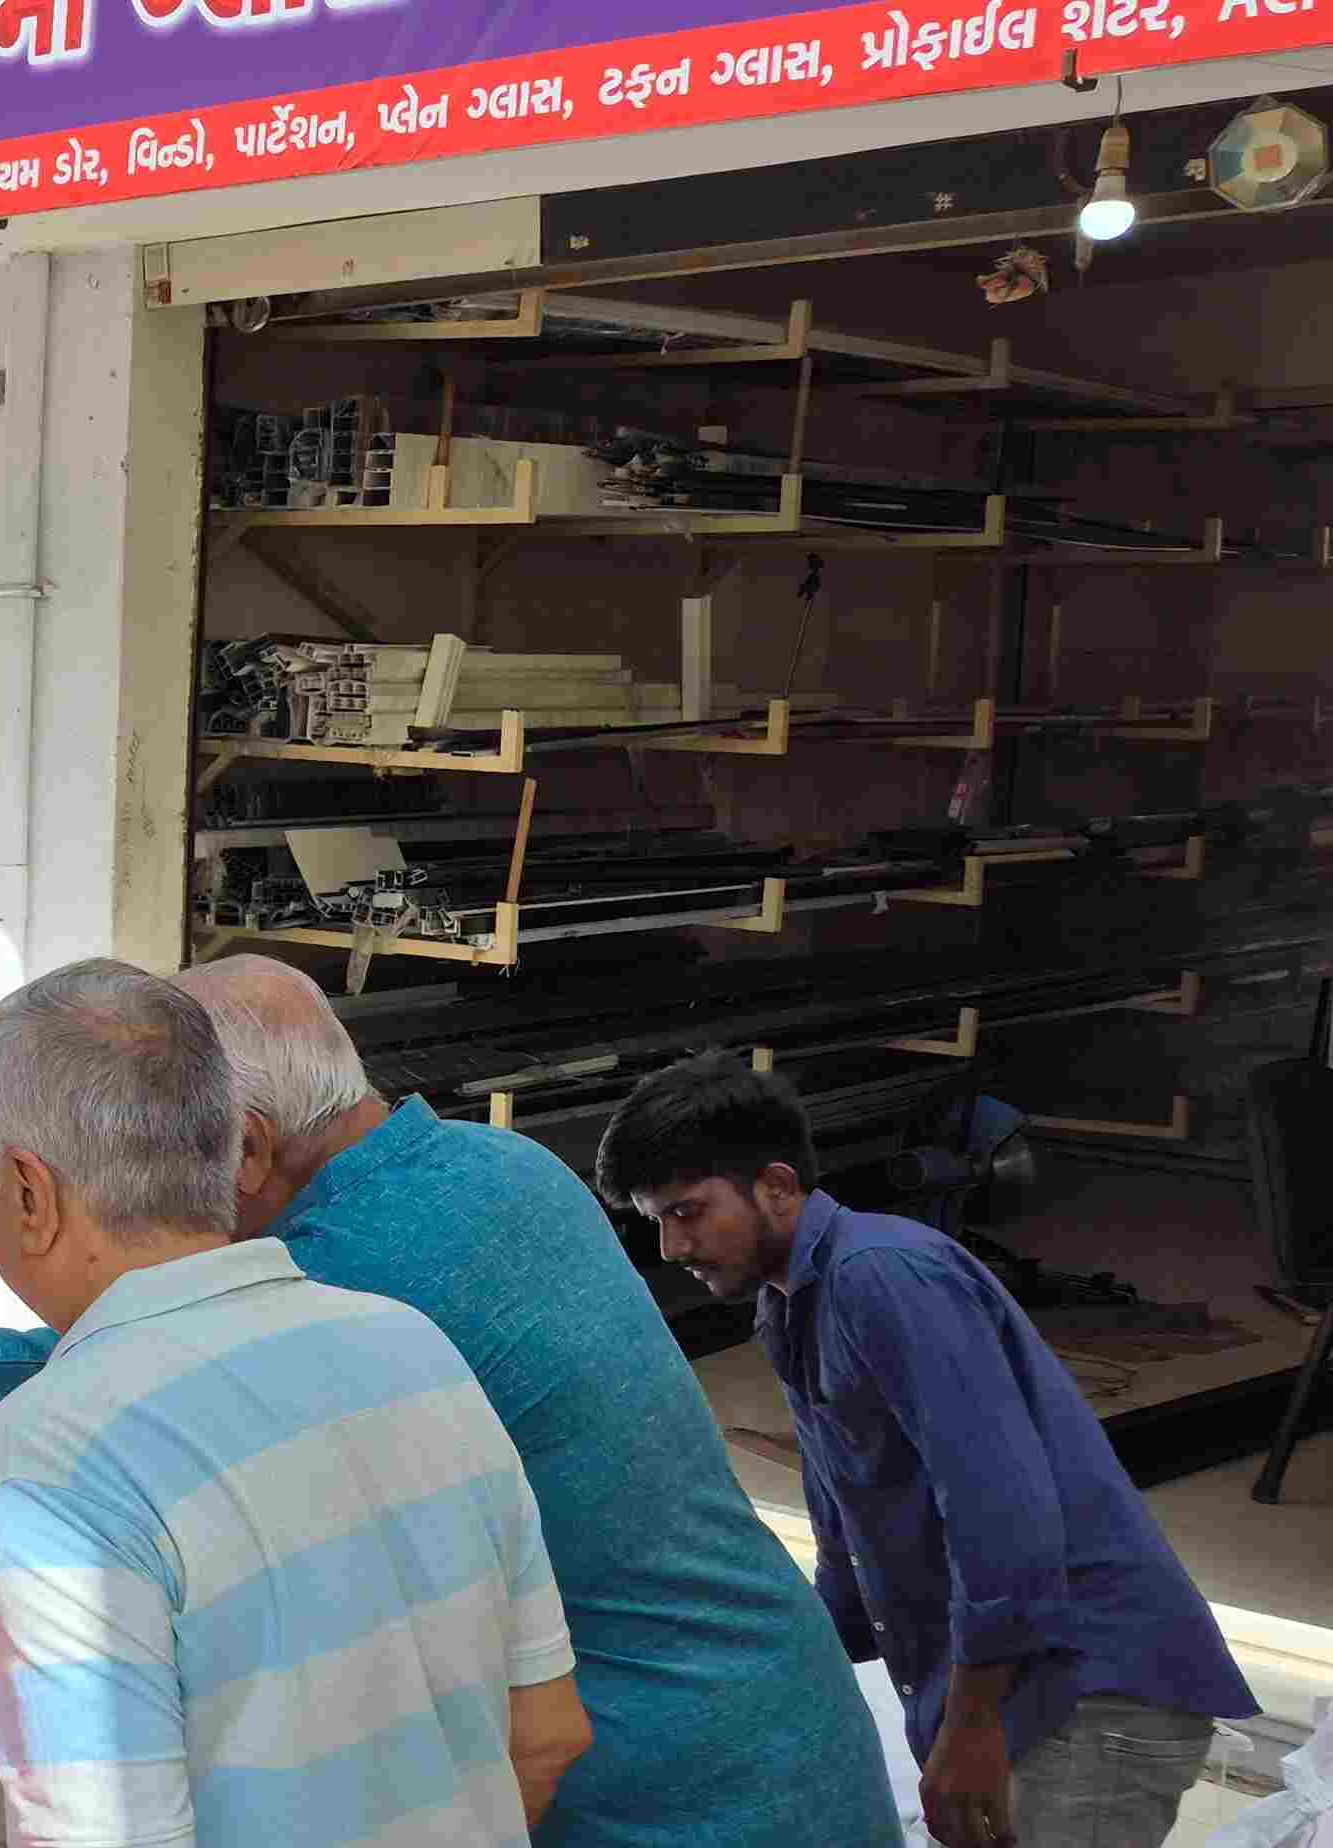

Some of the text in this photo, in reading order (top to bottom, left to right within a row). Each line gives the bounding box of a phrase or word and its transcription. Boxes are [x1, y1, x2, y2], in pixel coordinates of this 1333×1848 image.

[53, 138, 108, 186] ડોર,
[127, 118, 214, 175] વિન્ડો,
[235, 103, 354, 157] પાર્ટેશન,
[378, 84, 448, 136] પ્લેન
[467, 76, 573, 121] ગ્લાસ,
[597, 57, 691, 108] ટફન
[710, 40, 833, 87] ગ્લાસ,
